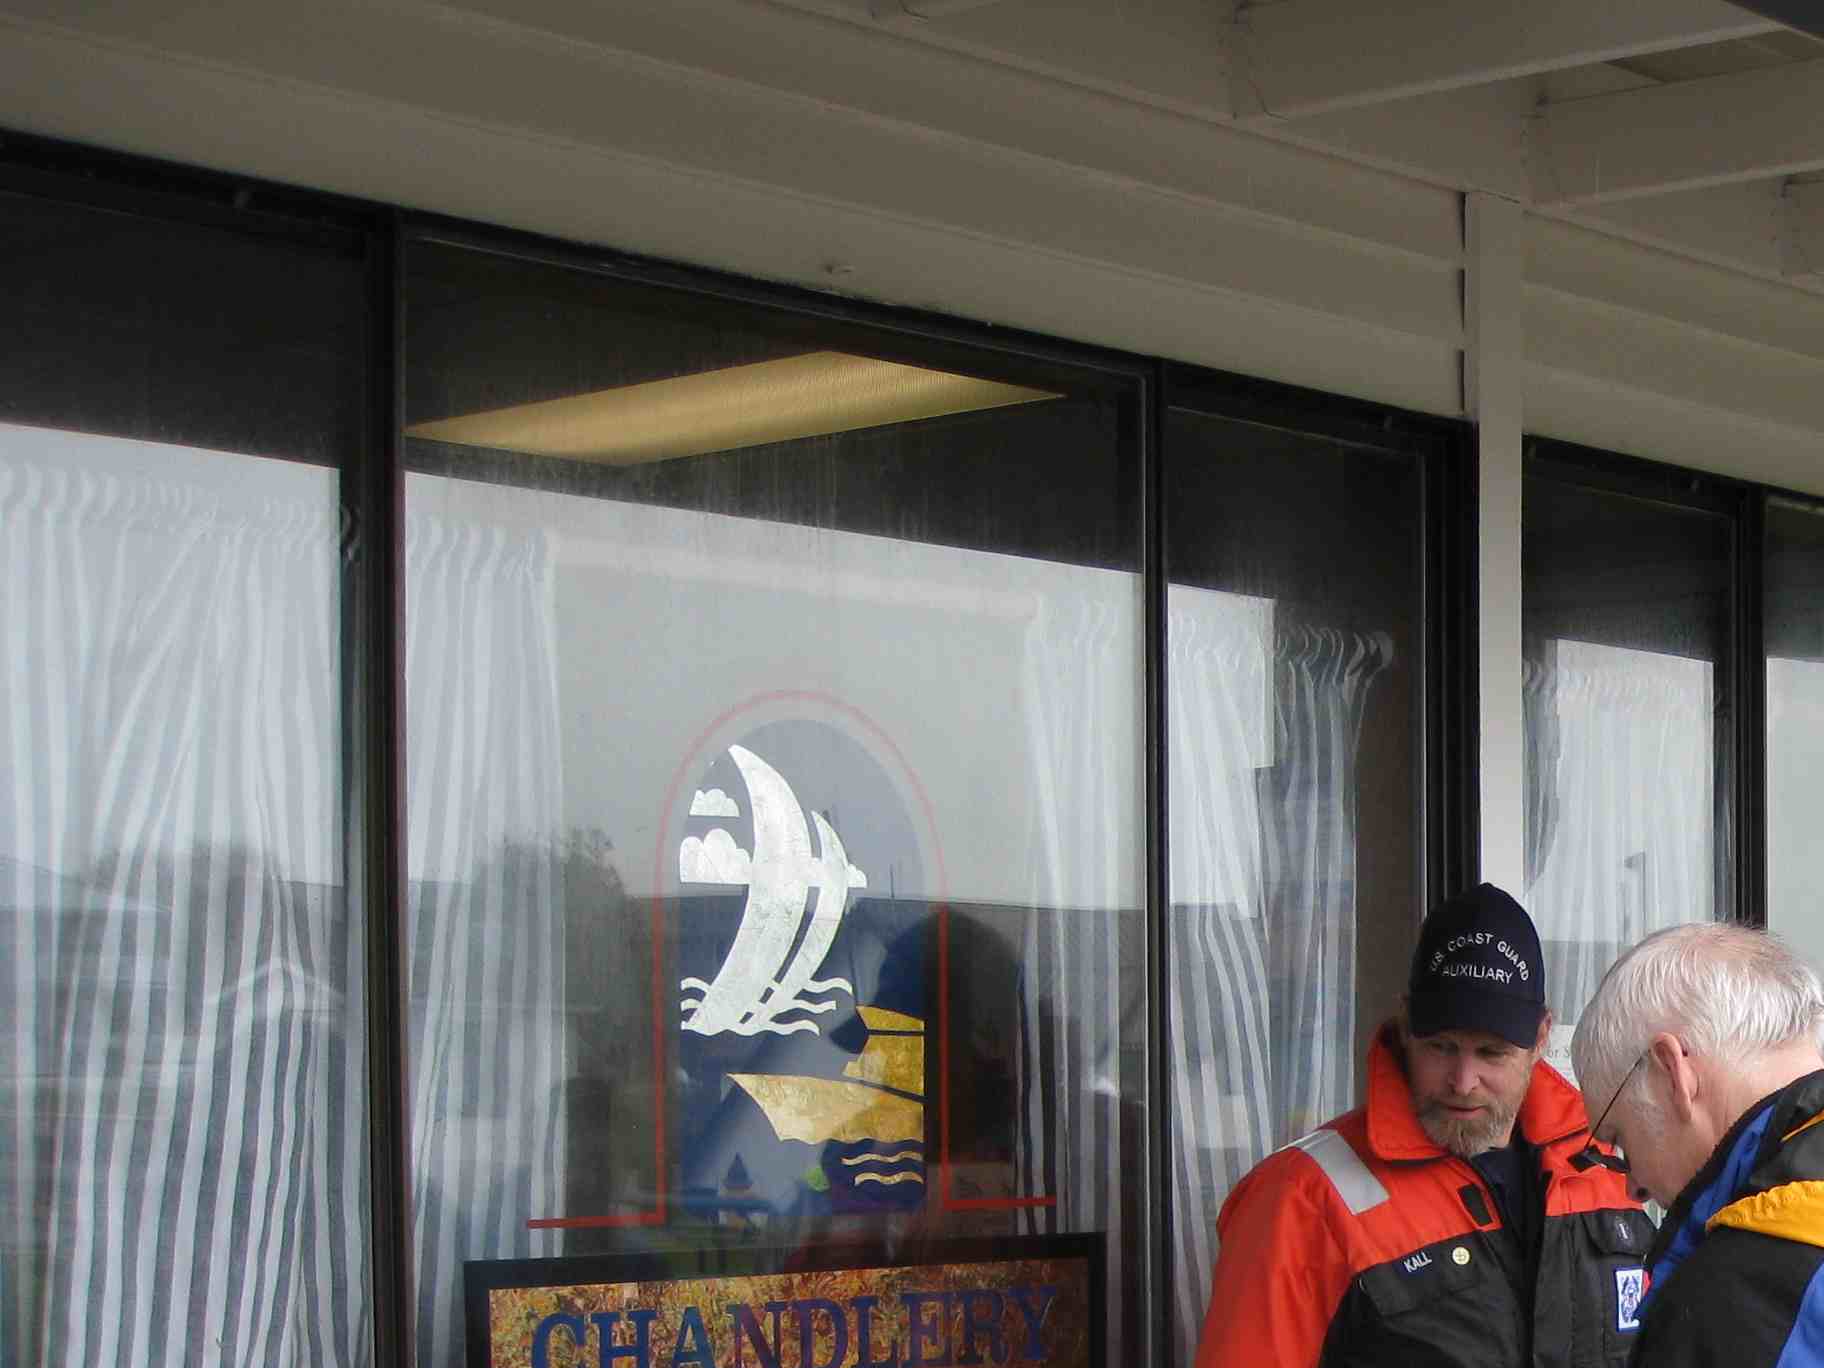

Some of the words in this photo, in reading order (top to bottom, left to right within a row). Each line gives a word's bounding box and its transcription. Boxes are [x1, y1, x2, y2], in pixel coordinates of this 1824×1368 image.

[1447, 932, 1494, 952] COAST
[1496, 940, 1530, 982] GUARD
[1442, 963, 1514, 985] AUXILIARY
[1403, 1252, 1433, 1273] KALL
